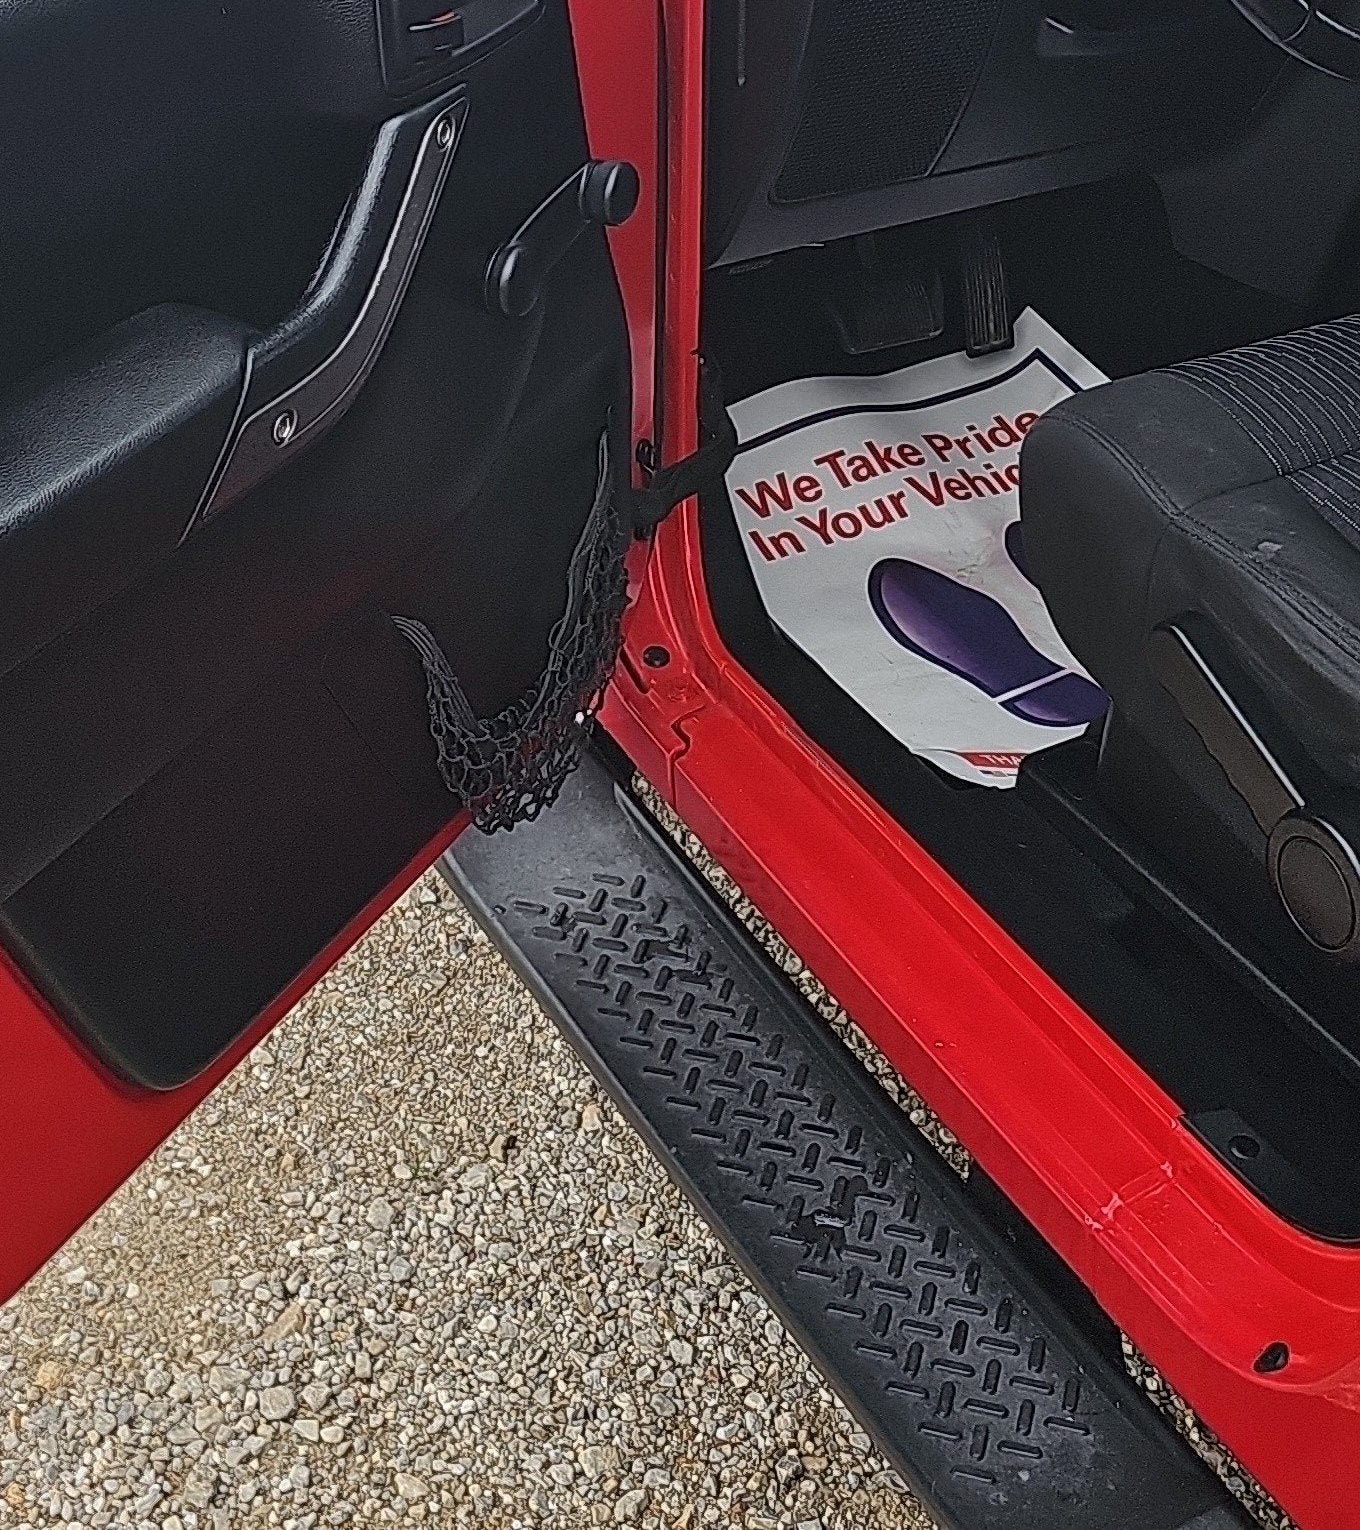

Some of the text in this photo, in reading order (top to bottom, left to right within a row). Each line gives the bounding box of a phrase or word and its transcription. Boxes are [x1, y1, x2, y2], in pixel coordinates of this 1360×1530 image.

[735, 411, 1040, 519] We Take Pride
[748, 529, 806, 562] In
[795, 489, 909, 546] Your
